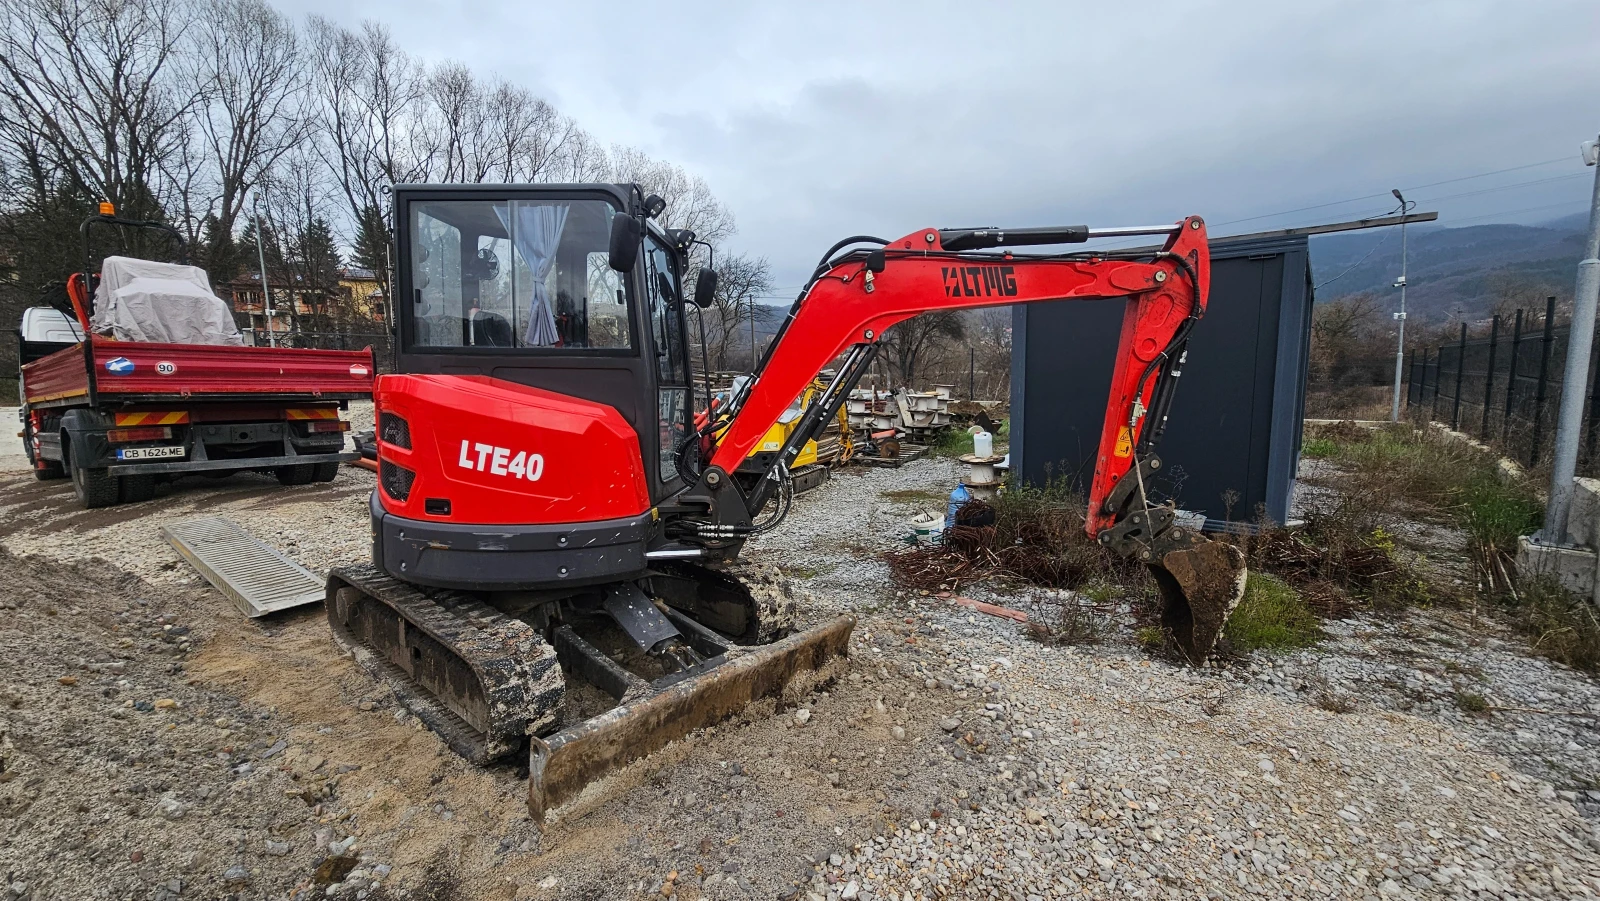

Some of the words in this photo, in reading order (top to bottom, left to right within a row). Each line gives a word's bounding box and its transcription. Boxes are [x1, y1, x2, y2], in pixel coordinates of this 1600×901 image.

[158, 364, 173, 372] 90
[124, 450, 139, 458] CB
[142, 448, 167, 457] 1626
[169, 447, 183, 455] ME
[458, 439, 544, 482] LTE40
